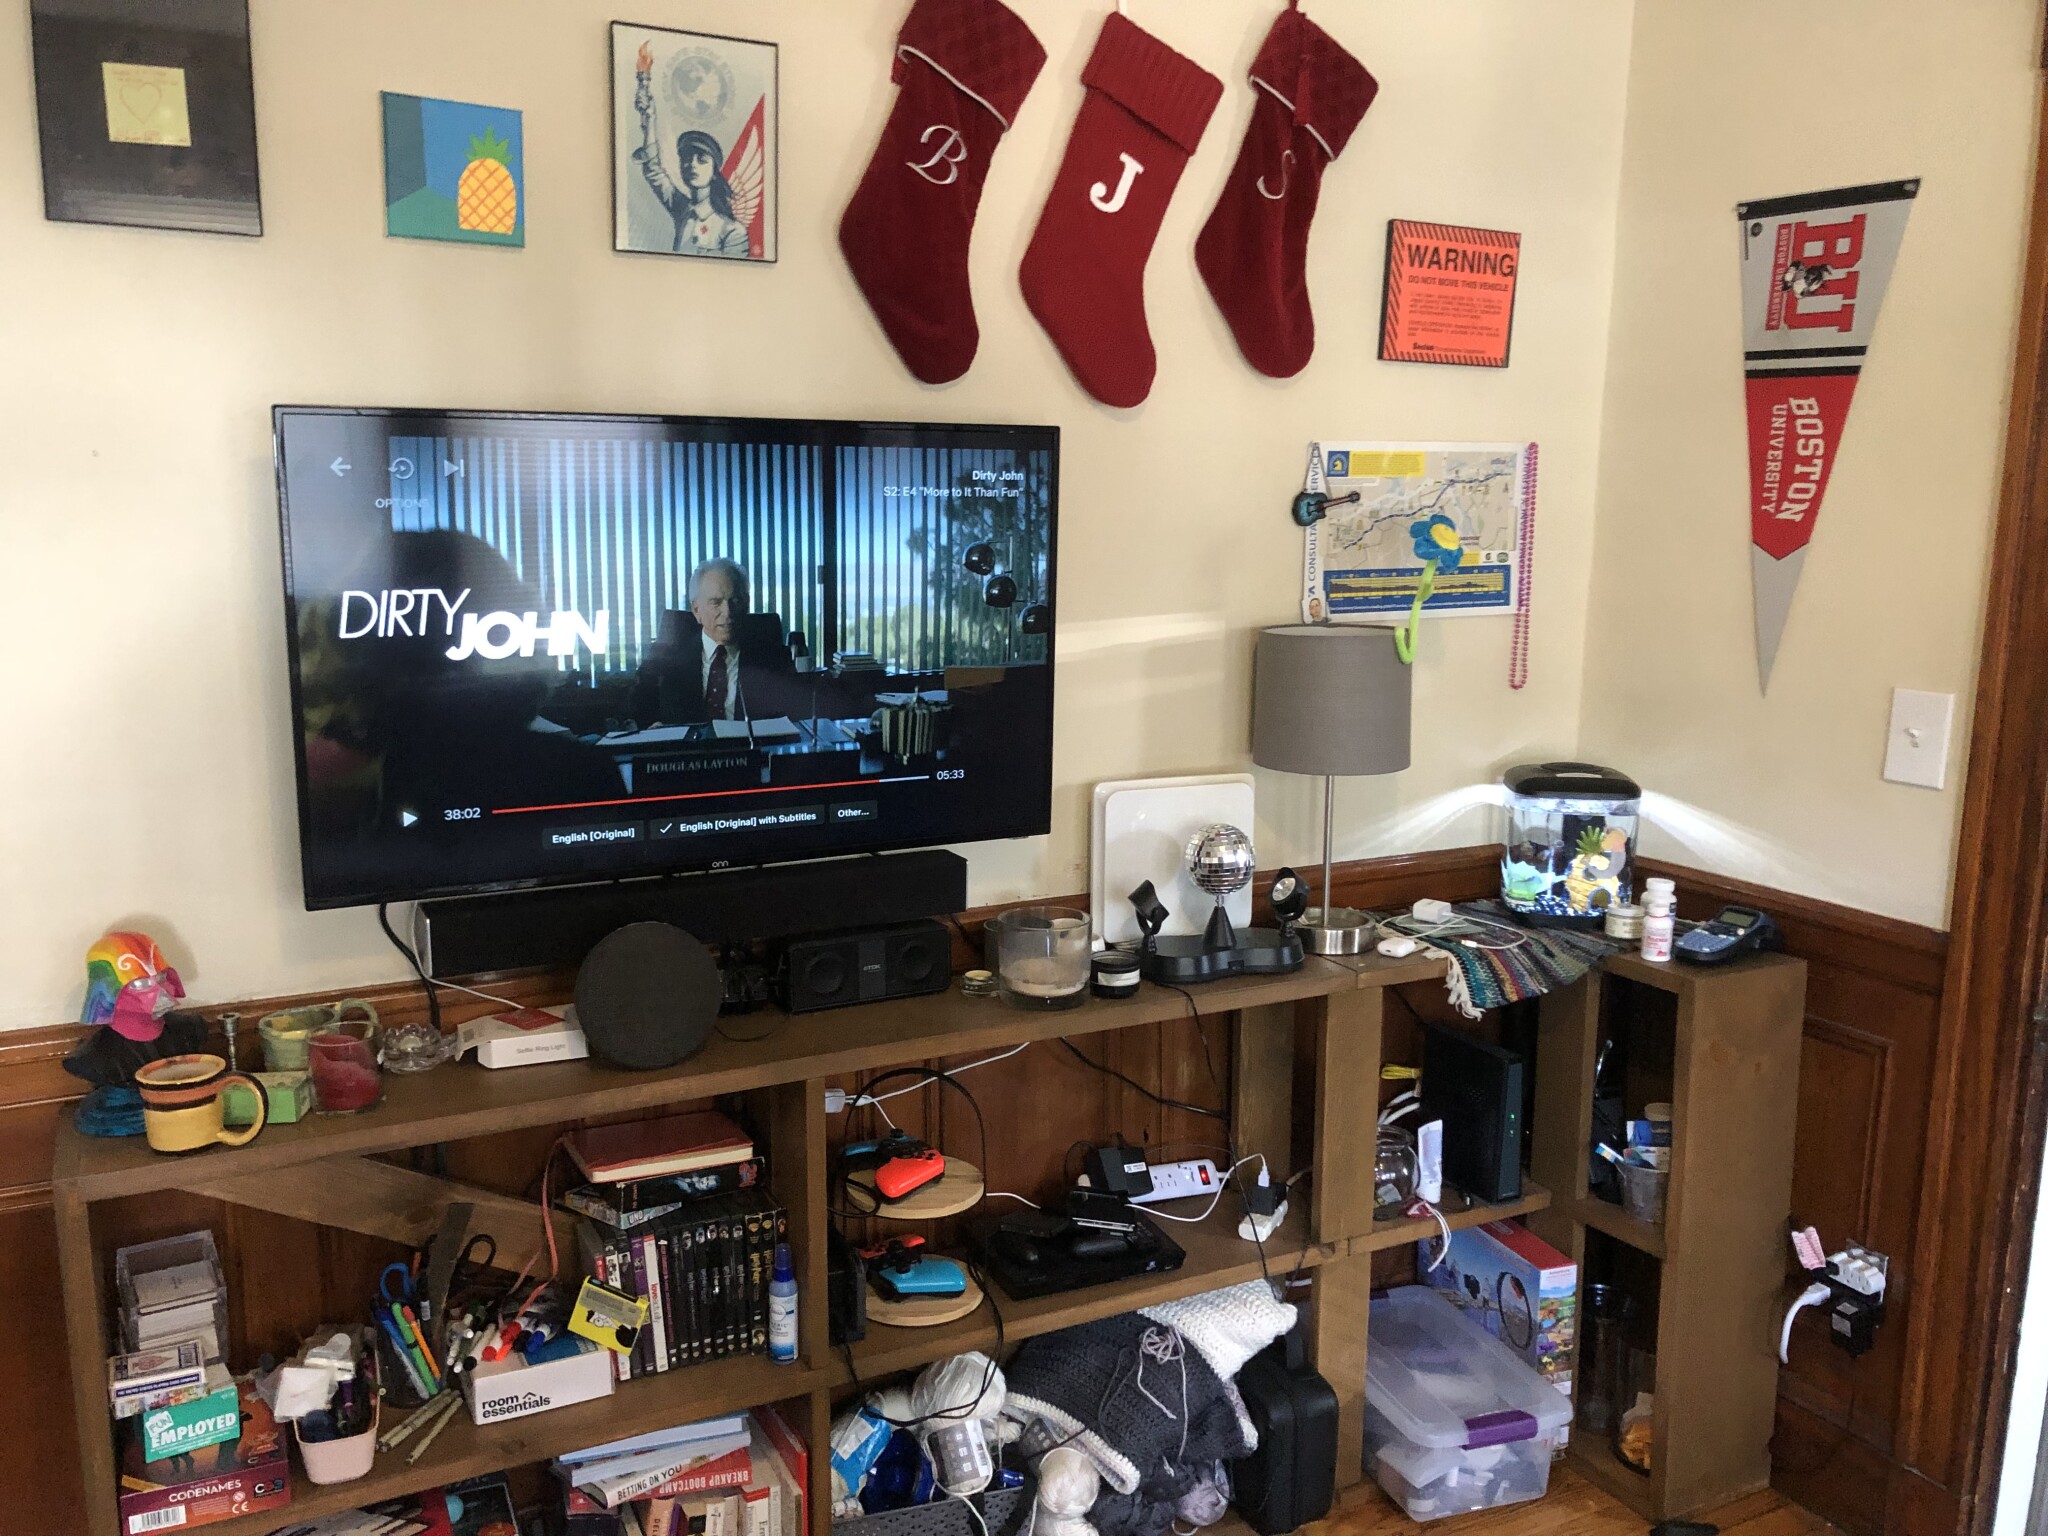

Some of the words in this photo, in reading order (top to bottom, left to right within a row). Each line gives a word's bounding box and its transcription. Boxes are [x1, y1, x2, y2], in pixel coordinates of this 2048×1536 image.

[905, 124, 968, 185] B
[1089, 152, 1145, 214] J
[1407, 243, 1515, 278] WARNING
[1784, 213, 1867, 332] BU
[1408, 275, 1419, 284] DO
[1421, 276, 1437, 286] NOT
[1438, 278, 1459, 288] MOVE
[1461, 280, 1477, 290] THIS
[1480, 281, 1509, 292] VEHICLE
[1761, 403, 1789, 513] UNIVERSITY
[1776, 397, 1825, 522] BOSTON
[972, 470, 996, 482] Dirty
[999, 470, 1024, 481] John
[883, 486, 901, 497] S2:
[903, 486, 917, 497] E4
[952, 488, 962, 498] to
[964, 487, 972, 498] It
[974, 487, 999, 498] Than
[375, 498, 430, 508] OPTIONS
[339, 587, 471, 639] DIRTY
[445, 609, 610, 661] JOHN
[646, 760, 700, 773] DOUGLAS
[703, 756, 748, 770] LAYTON
[936, 769, 965, 781] 05:33
[443, 807, 481, 821] 38:02
[838, 807, 870, 819] Other...
[679, 820, 714, 834] English
[715, 816, 757, 831] [Original]
[758, 814, 777, 825] with
[778, 811, 817, 823] Subtitles
[552, 831, 588, 845] English
[589, 827, 635, 843] [Original]
[535, 1044, 550, 1053] Ring
[551, 1043, 566, 1051] Light
[628, 1210, 644, 1225] UNO
[650, 1283, 658, 1300] love
[482, 1395, 519, 1410] room
[483, 1396, 551, 1419] essentials
[151, 1412, 237, 1449] EMPLOYED
[617, 1479, 648, 1501] BETTING
[649, 1475, 660, 1487] ON
[661, 1464, 683, 1481] YOU
[659, 1476, 707, 1494] BOOTCAMP
[709, 1470, 749, 1487] BREAKUP
[168, 1479, 242, 1503] CODENAMES
